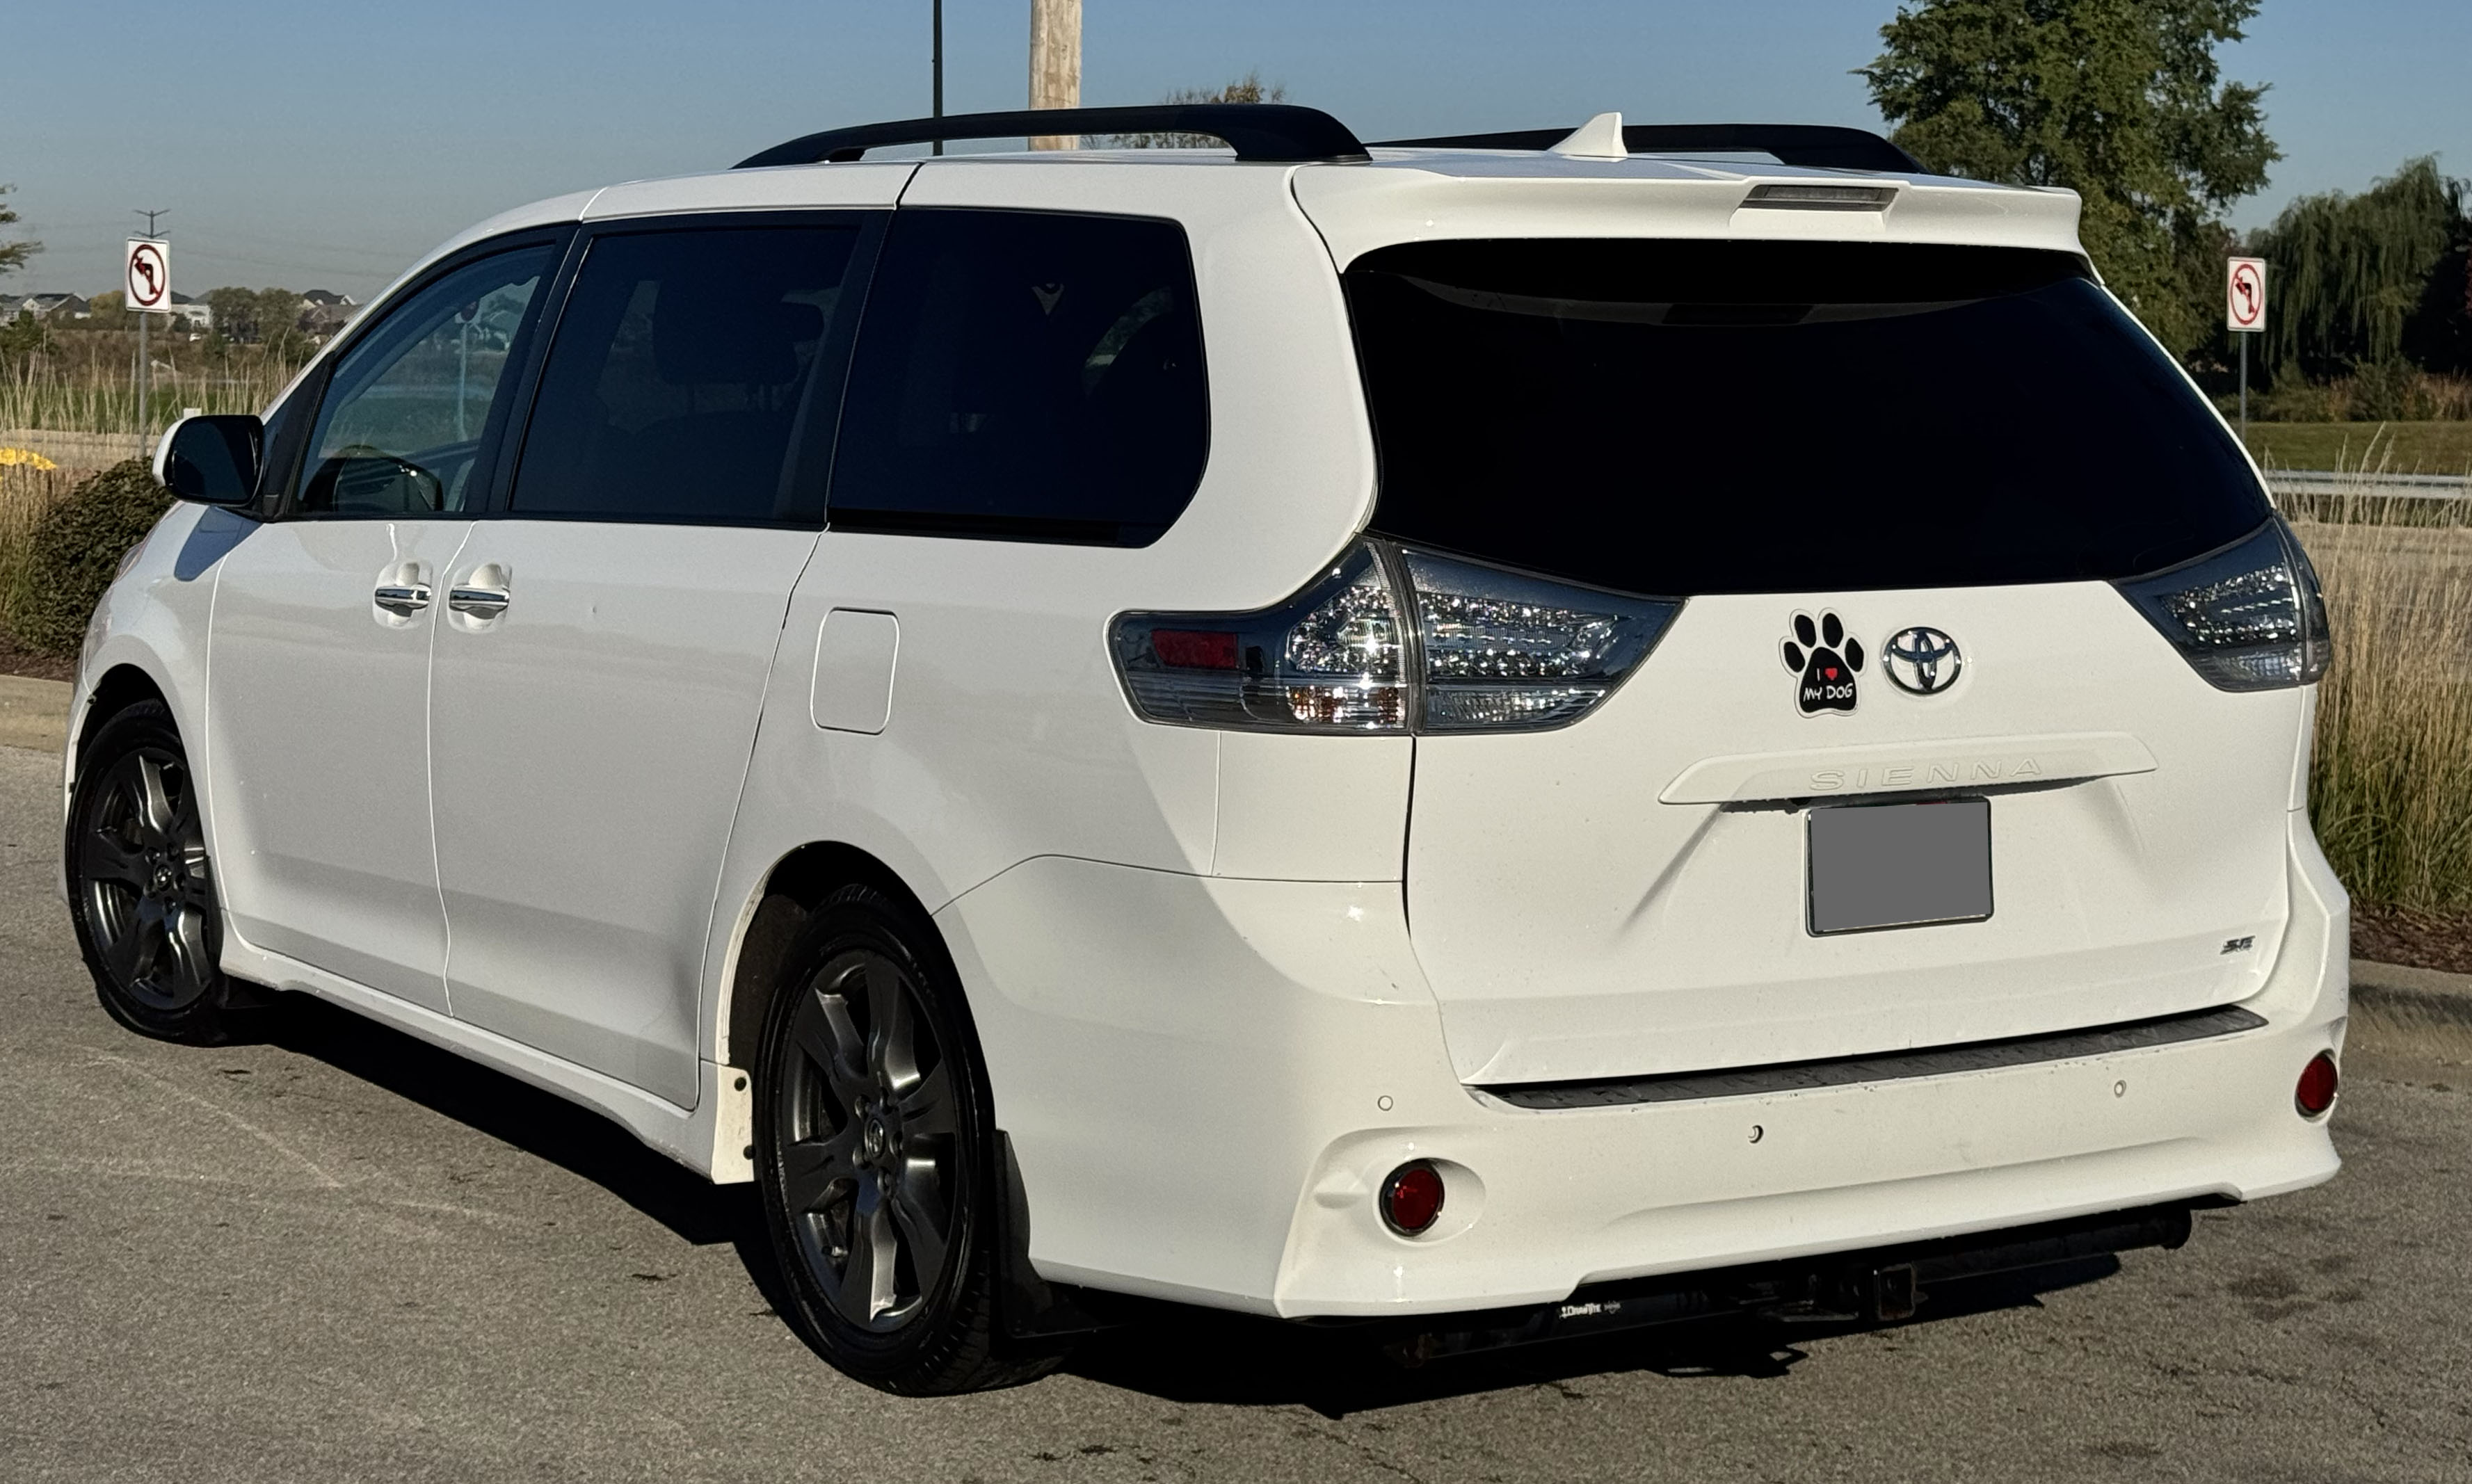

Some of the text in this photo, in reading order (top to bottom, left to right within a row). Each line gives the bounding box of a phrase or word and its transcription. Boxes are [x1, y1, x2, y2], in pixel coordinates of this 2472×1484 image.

[1816, 668, 1821, 681] I
[1803, 682, 1854, 702] MY DOG
[1809, 758, 2042, 791] SIENNA
[2220, 935, 2256, 955] SE
